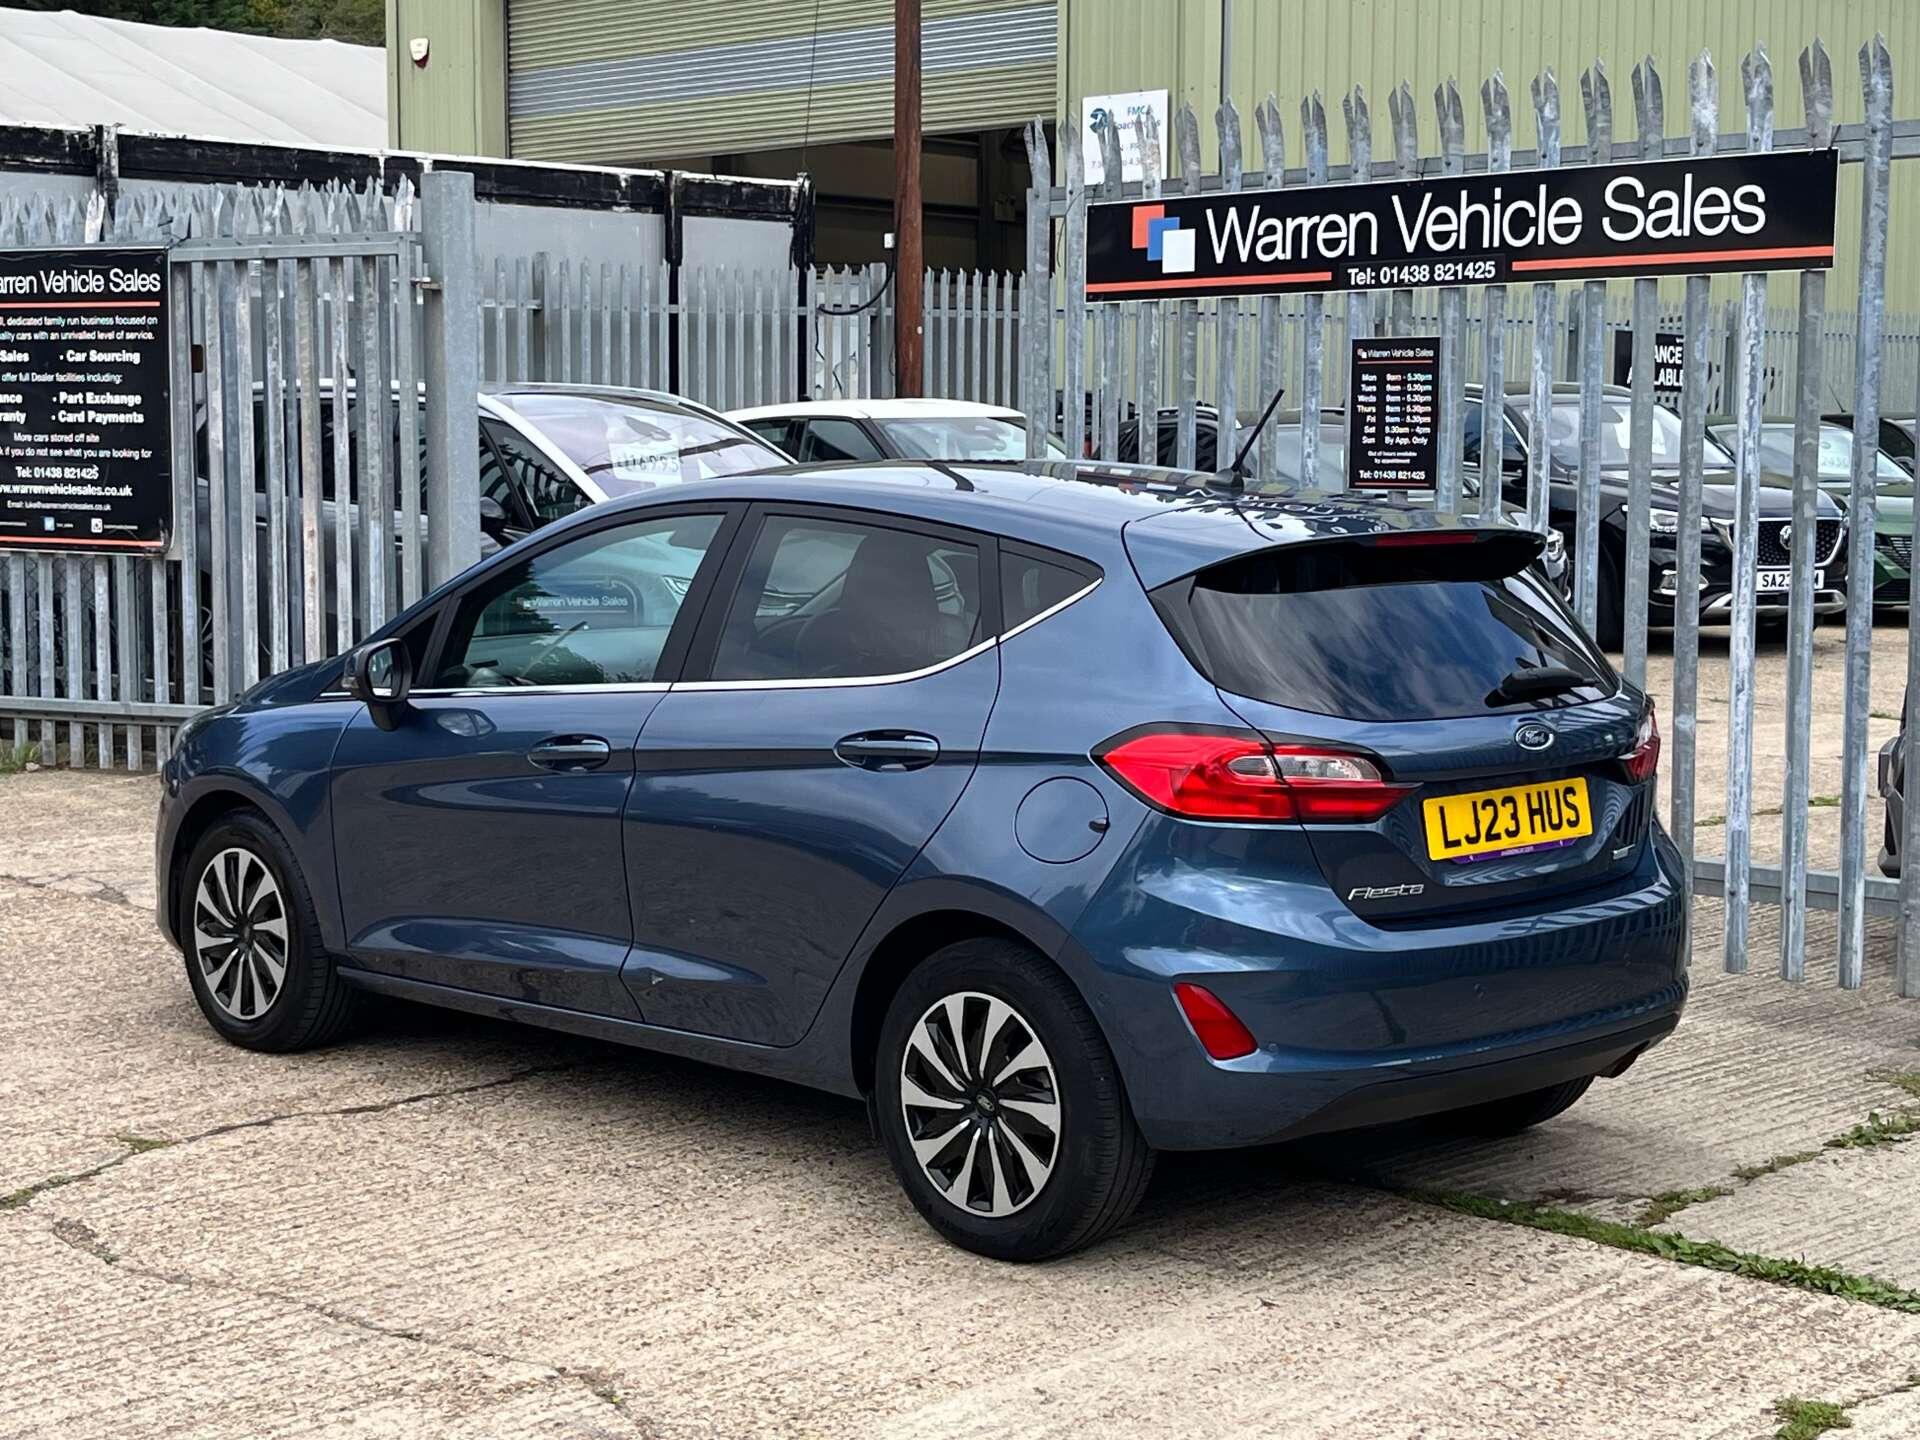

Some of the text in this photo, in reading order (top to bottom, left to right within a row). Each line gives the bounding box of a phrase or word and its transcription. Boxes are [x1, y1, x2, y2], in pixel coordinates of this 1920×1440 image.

[1205, 173, 1766, 264] Warren Vehicle Sales
[1347, 261, 1496, 285] Tel: 01438 821425
[39, 269, 105, 293] Vehicle
[109, 268, 161, 292] Sales
[7, 316, 43, 326] dedicated
[44, 316, 65, 327] family
[81, 316, 114, 325] business
[115, 315, 146, 325] focused
[147, 317, 158, 325] on
[16, 332, 32, 340] cars
[33, 331, 49, 340] with
[50, 332, 59, 340] an
[97, 330, 115, 340] level
[116, 330, 124, 340] of
[66, 350, 87, 362] Car
[89, 349, 140, 364] Sourcing
[1367, 347, 1434, 358] Warren Vehicle Sales
[1654, 344, 1683, 364] ANCE
[1361, 384, 1377, 392] Tues
[60, 392, 84, 404] Part
[86, 392, 142, 407] Exchange
[1356, 405, 1376, 413] Thurs
[58, 410, 85, 423] Card
[88, 410, 144, 425] Payments
[1366, 415, 1376, 423] Fri
[14, 432, 100, 442] More cars stored off site
[1361, 436, 1376, 444] Sun
[1384, 436, 1394, 445] By
[1412, 436, 1428, 445] Only
[11, 448, 24, 458] you
[25, 447, 35, 456] do
[36, 447, 48, 456] not
[50, 449, 63, 457] see
[64, 448, 82, 457] what
[83, 449, 97, 459] you
[98, 449, 111, 458] are
[112, 448, 140, 460] looking
[141, 448, 153, 458] for
[33, 467, 62, 478] 01438
[64, 466, 99, 480] 821425
[1359, 470, 1426, 480] Tel: 01438 821425
[567, 596, 600, 607] Vehicle
[601, 596, 628, 607] Sales
[1439, 786, 1581, 849] LJ23 HUS
[1348, 884, 1425, 901] Fiesta
